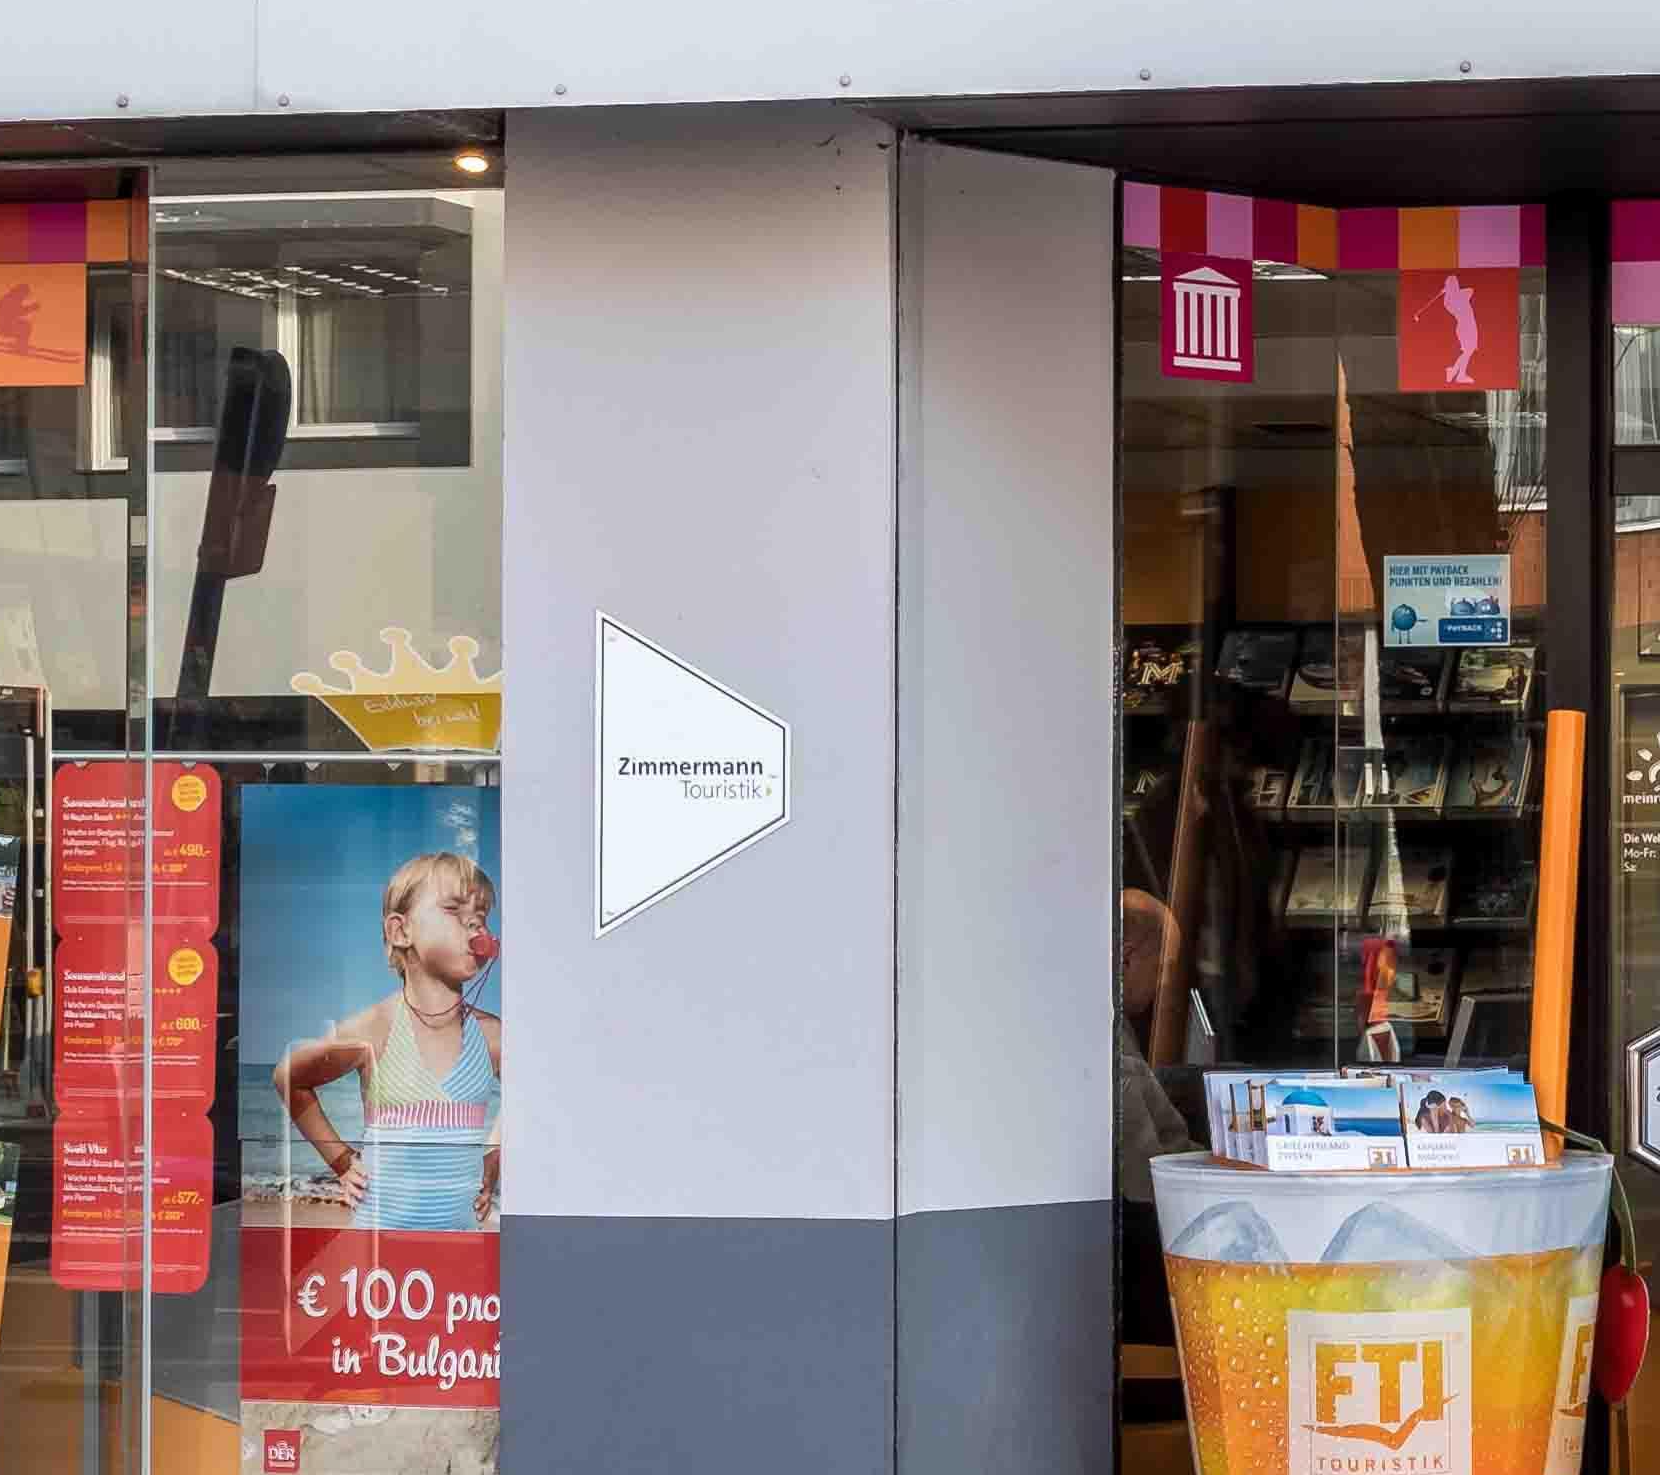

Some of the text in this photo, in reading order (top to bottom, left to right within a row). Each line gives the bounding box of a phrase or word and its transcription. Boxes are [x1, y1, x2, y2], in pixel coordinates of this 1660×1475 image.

[1389, 564, 1411, 576] HIER
[1412, 564, 1429, 576] MIT
[1389, 576, 1431, 587] PUNKTEN
[617, 756, 764, 777] Zimmermann
[679, 779, 763, 800] Touristik
[1622, 832, 1640, 844] Die
[340, 1266, 436, 1321] 100
[445, 1288, 500, 1335] pro
[331, 1336, 362, 1376] in
[1314, 1340, 1445, 1424] FTI
[1317, 1454, 1446, 1474] TOURISTIK
